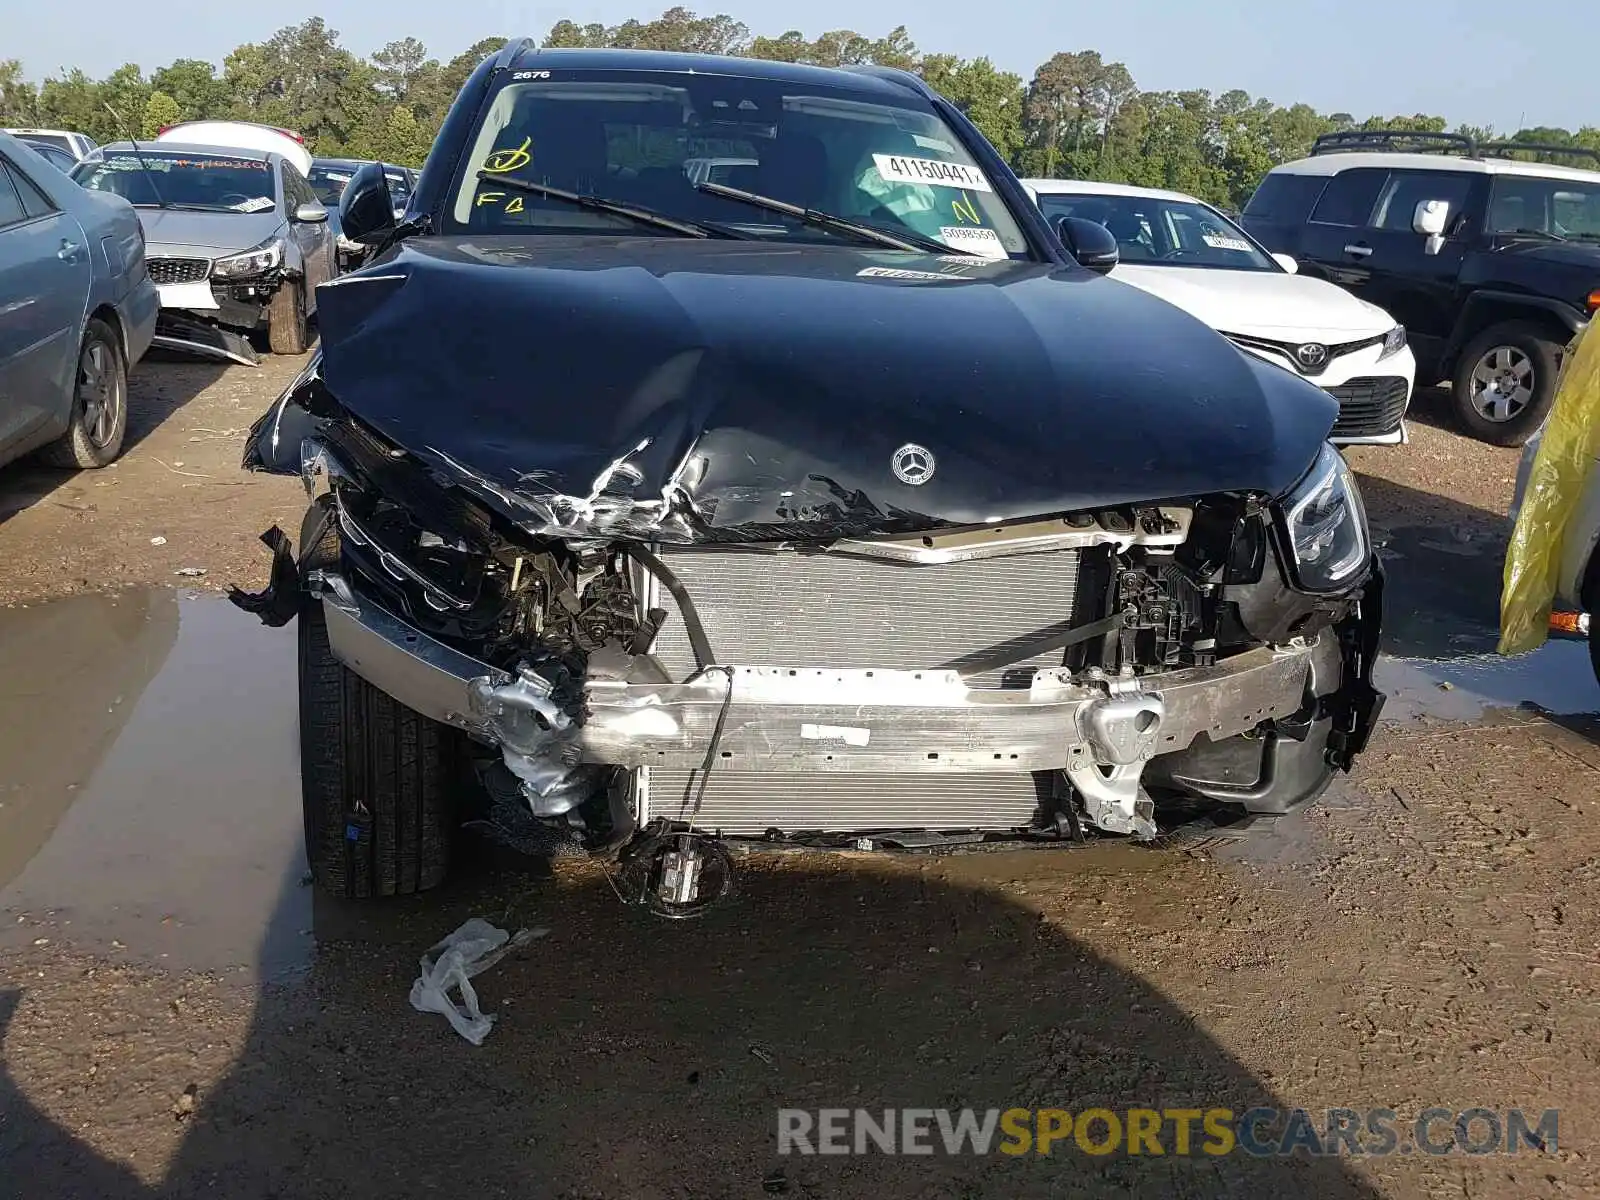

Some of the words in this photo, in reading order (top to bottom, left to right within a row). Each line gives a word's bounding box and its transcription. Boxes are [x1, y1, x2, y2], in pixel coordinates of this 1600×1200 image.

[512, 71, 551, 80] 2676
[889, 157, 974, 184] 41150441
[951, 189, 981, 225] N
[943, 228, 996, 241] 5098559
